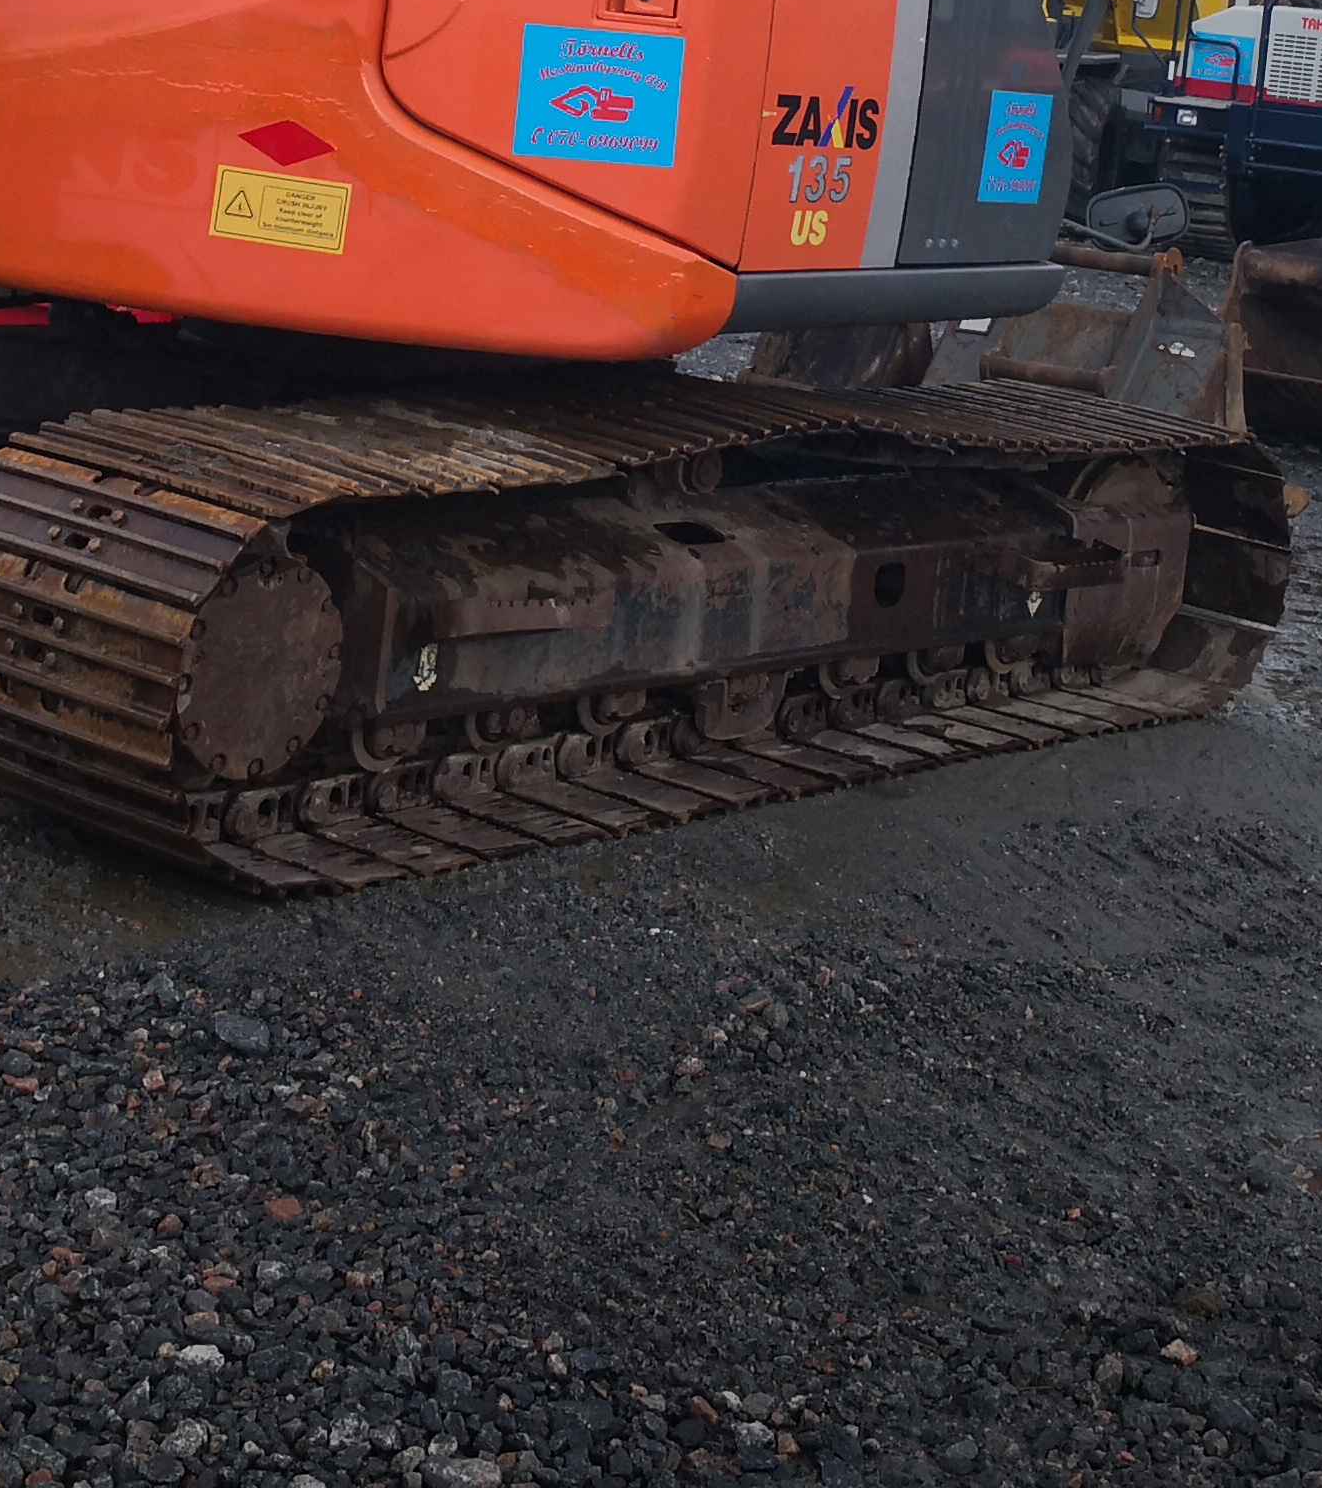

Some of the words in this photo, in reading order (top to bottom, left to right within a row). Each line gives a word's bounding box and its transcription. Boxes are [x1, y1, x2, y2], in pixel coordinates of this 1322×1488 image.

[771, 85, 880, 151] ZAXIS
[788, 153, 853, 204] 135
[790, 210, 829, 246] US
